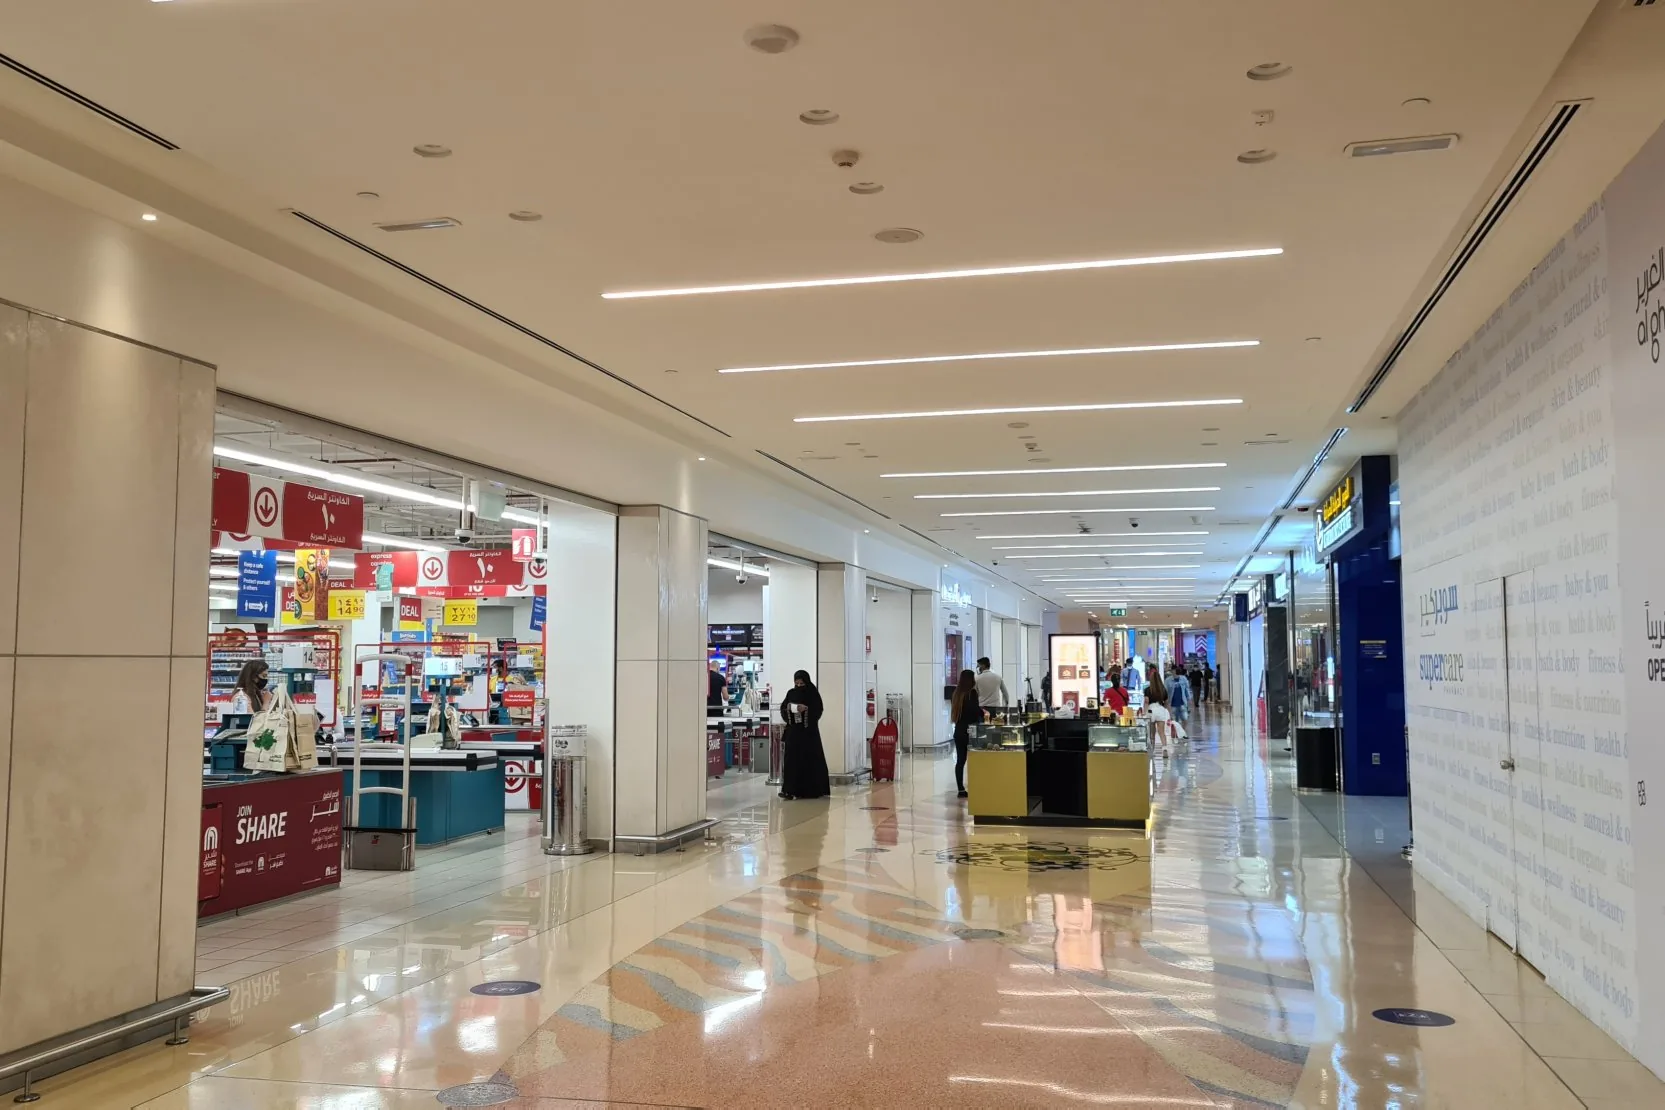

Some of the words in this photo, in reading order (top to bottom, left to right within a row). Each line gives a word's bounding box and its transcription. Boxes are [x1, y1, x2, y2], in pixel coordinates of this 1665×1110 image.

[1589, 438, 1609, 467] body
[307, 490, 327, 500] السريع
[321, 504, 335, 530] ١٠
[477, 558, 494, 578] ١٠
[1565, 575, 1584, 597] baby
[1593, 573, 1609, 598] you
[337, 607, 352, 616] 14
[401, 604, 419, 617] DEAL
[452, 614, 466, 622] 27
[304, 651, 313, 664] 14
[1563, 649, 1580, 677] body
[1588, 648, 1616, 673] fitness
[1420, 654, 1464, 691] supercare
[1594, 729, 1621, 758] health
[236, 805, 252, 817] JOIN
[310, 799, 339, 822] شير
[236, 812, 288, 844] SHARE
[1583, 811, 1613, 841] natural
[1615, 816, 1623, 842] &
[203, 860, 217, 868] SHARE
